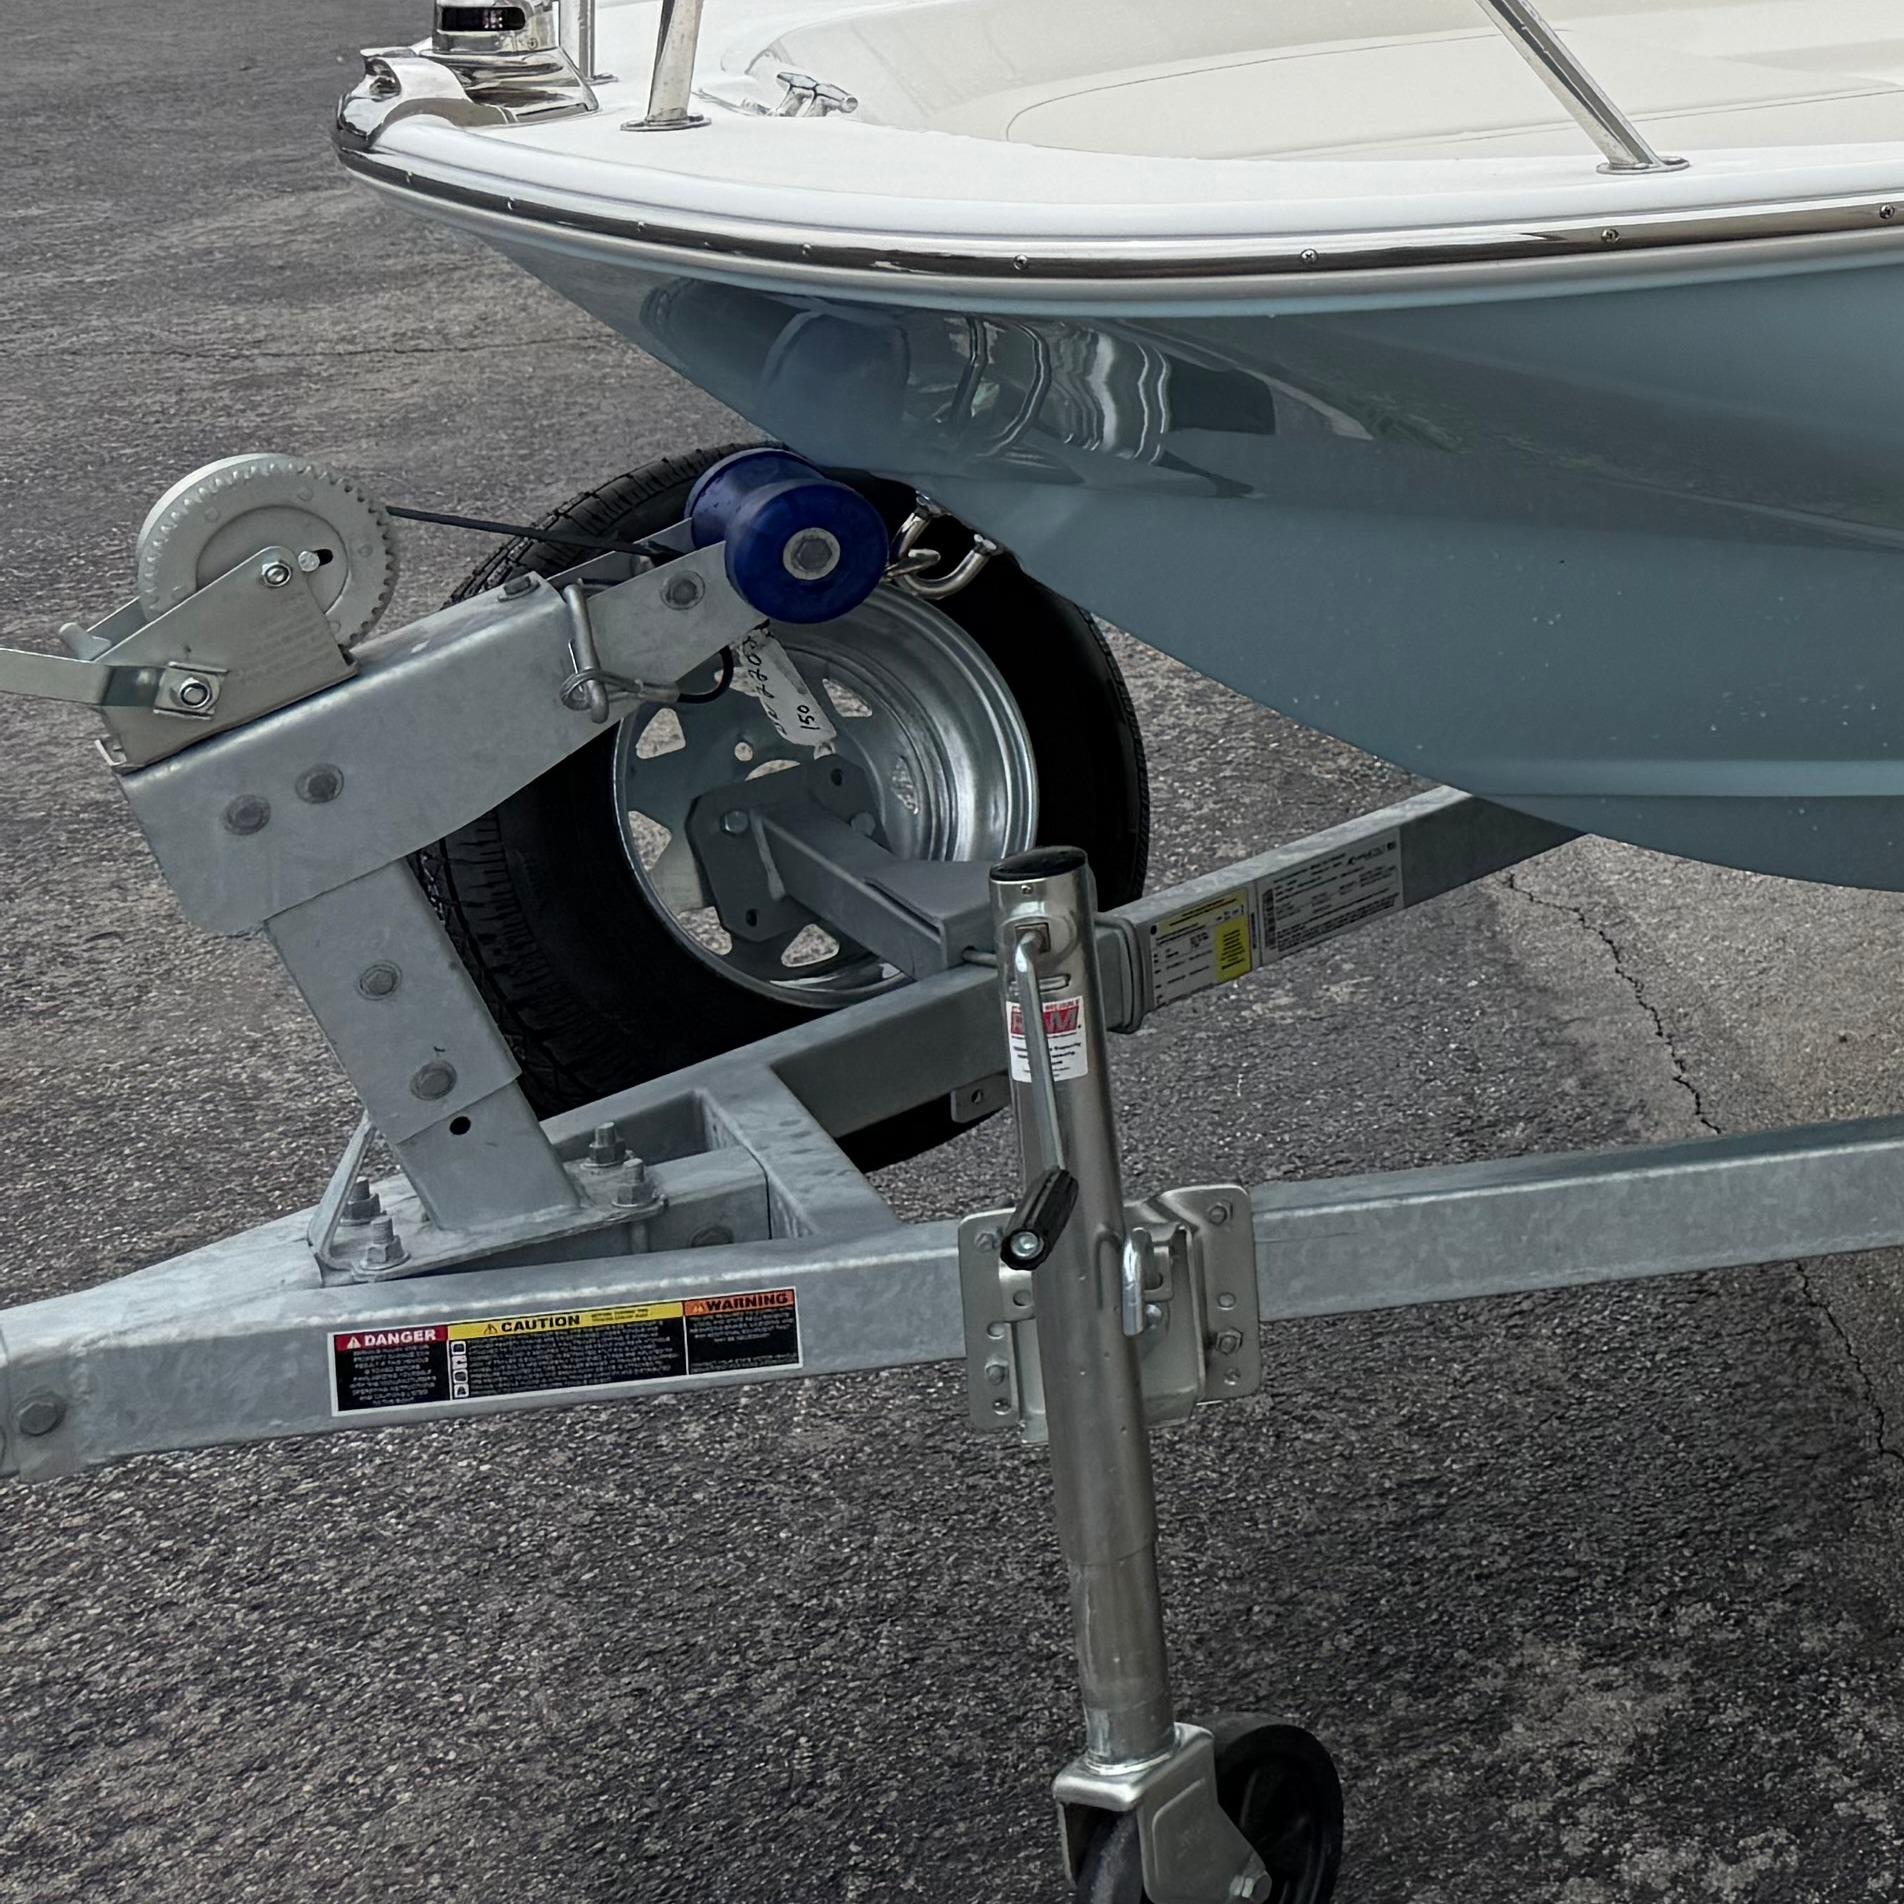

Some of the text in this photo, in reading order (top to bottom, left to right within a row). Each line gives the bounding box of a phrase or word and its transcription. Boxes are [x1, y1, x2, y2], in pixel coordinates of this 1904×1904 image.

[797, 704, 821, 730] 150
[706, 1293, 788, 1311] WARNING
[501, 1315, 580, 1334] CAUTION
[364, 1329, 437, 1346] DANGER
